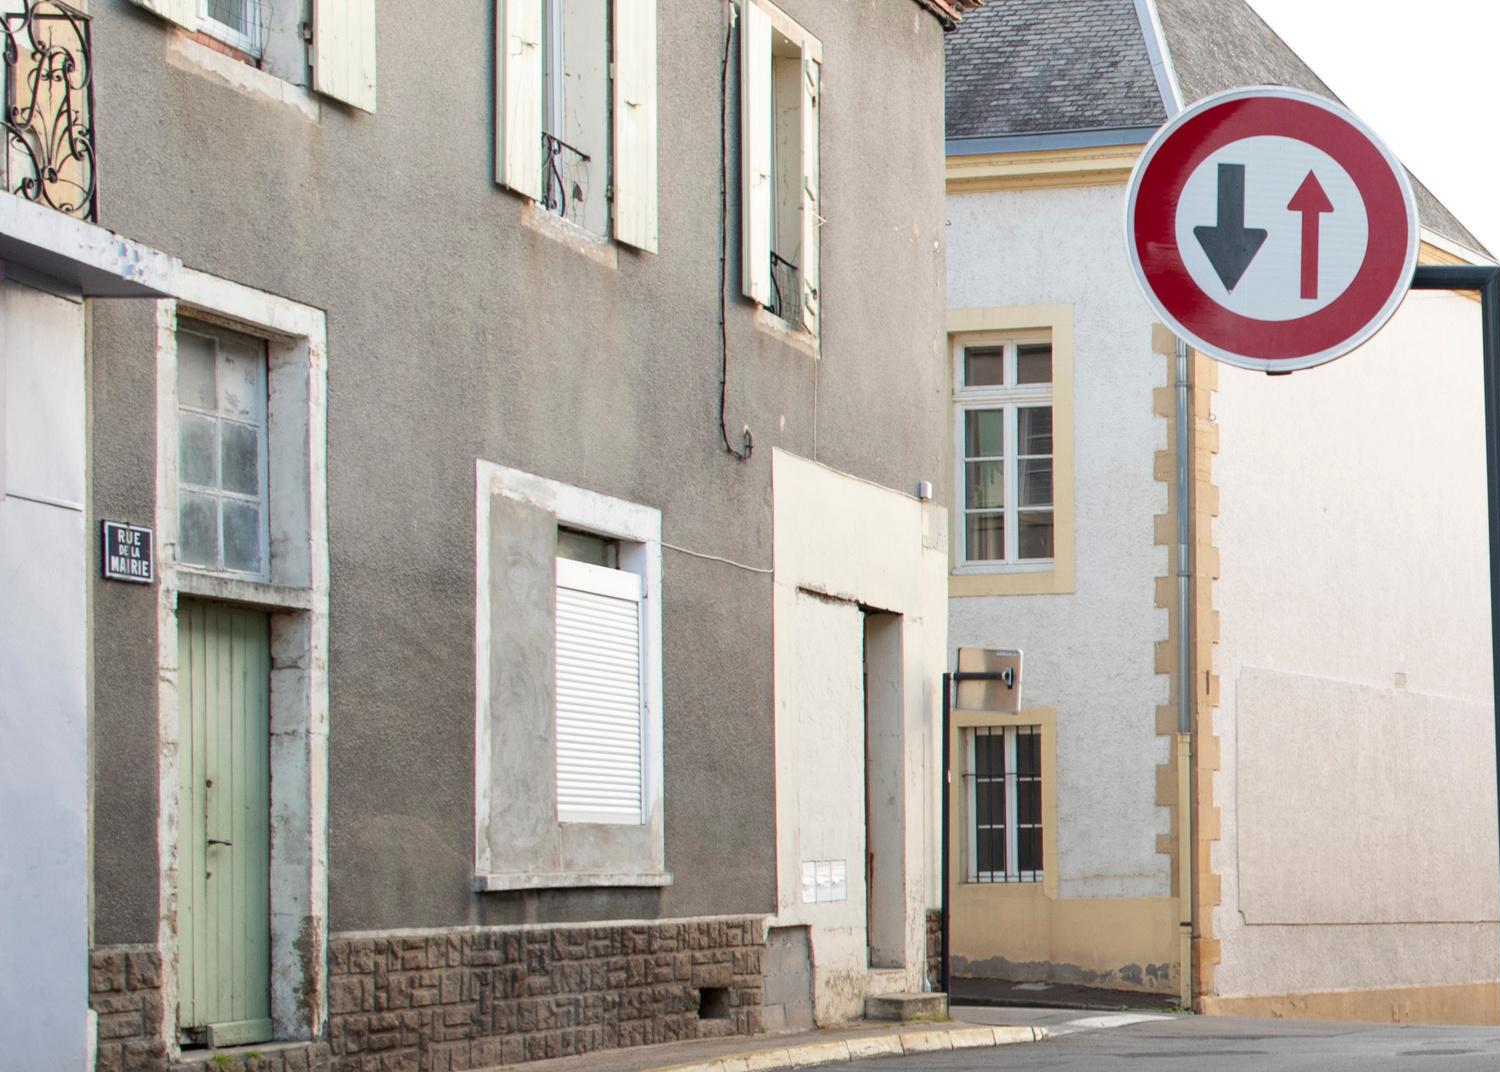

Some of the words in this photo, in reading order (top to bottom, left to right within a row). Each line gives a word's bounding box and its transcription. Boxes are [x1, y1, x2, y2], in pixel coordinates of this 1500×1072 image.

[117, 529, 141, 546] RUE
[119, 544, 129, 557] DE
[131, 546, 141, 559] LA
[111, 556, 149, 577] MAIRIE
